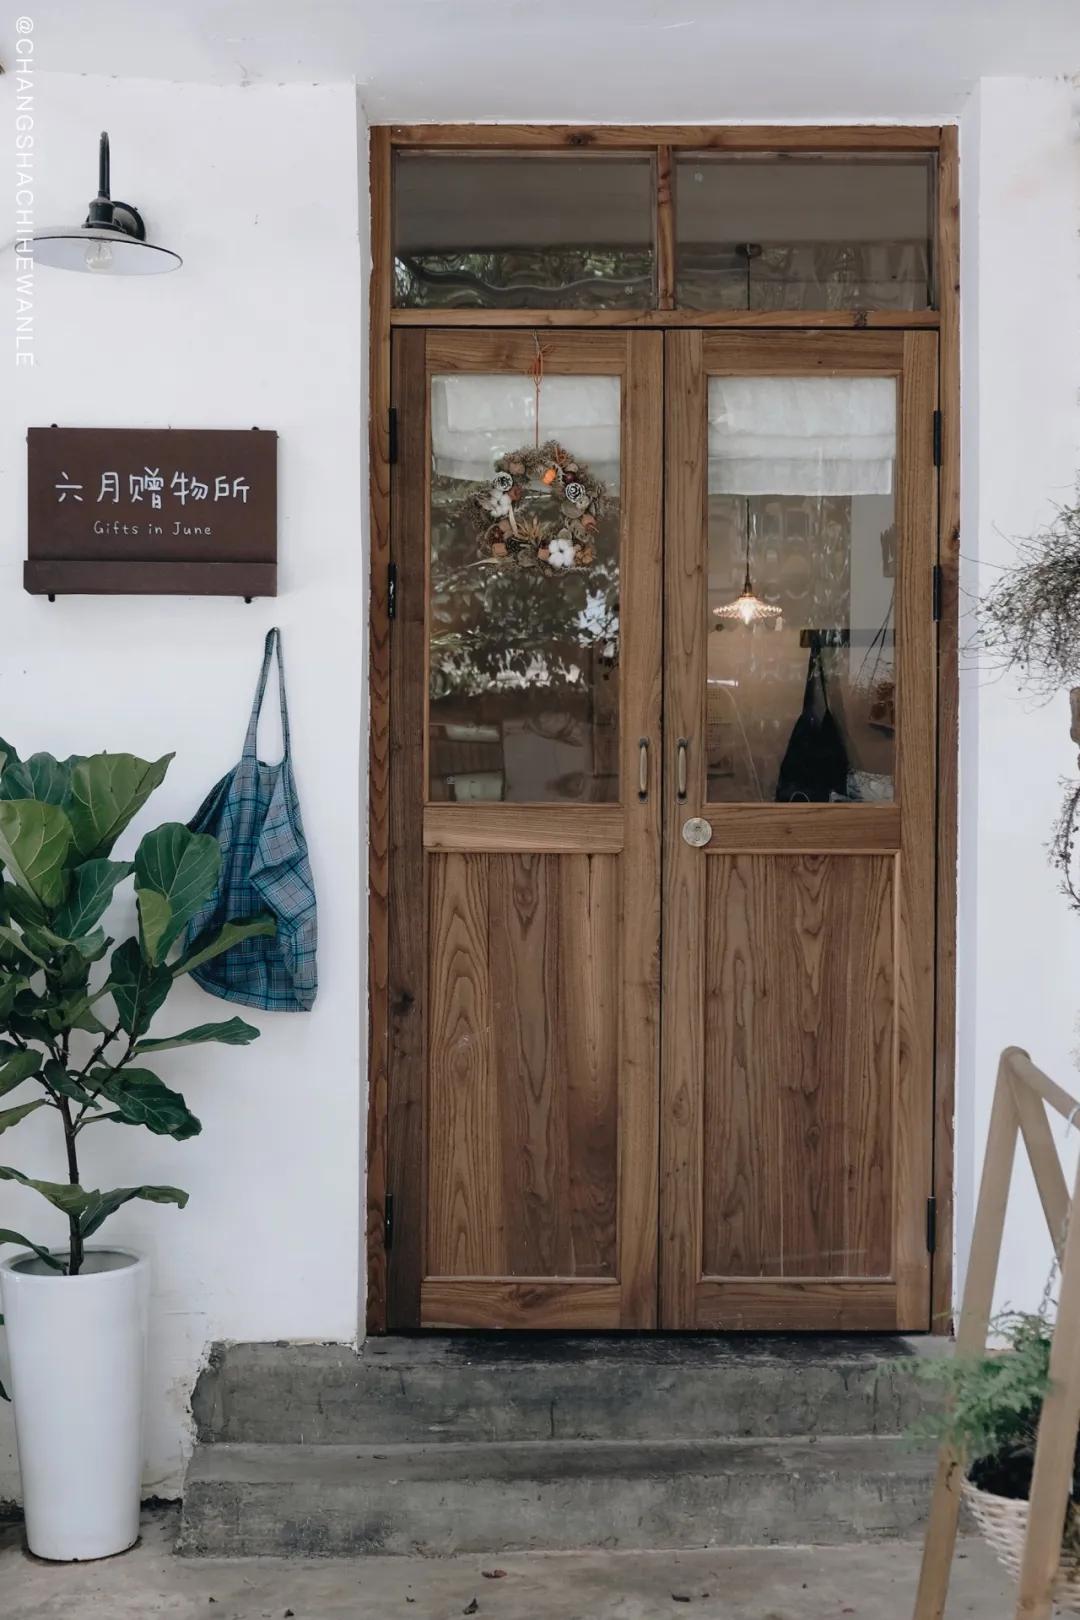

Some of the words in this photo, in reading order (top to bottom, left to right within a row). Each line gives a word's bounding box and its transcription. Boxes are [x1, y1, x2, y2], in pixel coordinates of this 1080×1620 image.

[55, 466, 250, 510] 六月赠物所
[93, 520, 138, 535] Gifts
[148, 523, 163, 535] in
[172, 521, 212, 536] June
